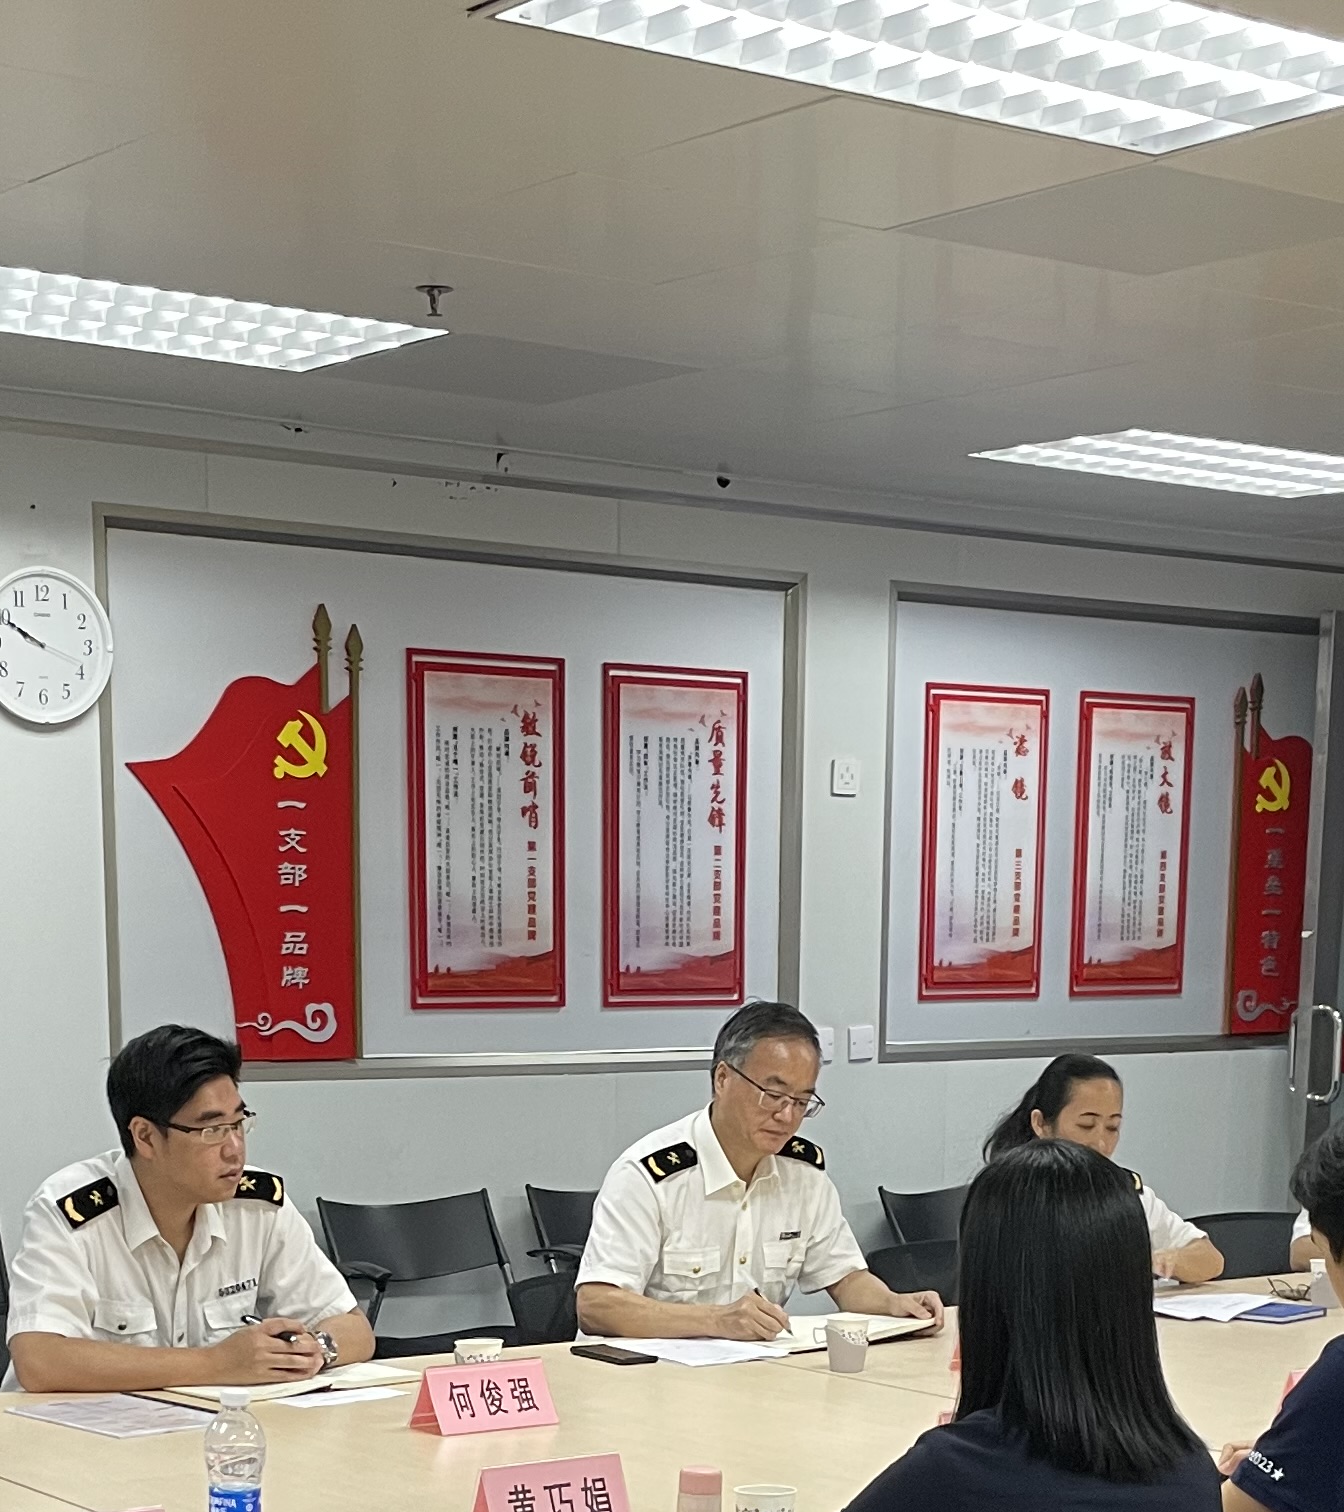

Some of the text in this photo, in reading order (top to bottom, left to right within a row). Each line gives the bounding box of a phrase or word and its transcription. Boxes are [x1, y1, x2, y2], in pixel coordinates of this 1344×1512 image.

[13, 590, 25, 607] 11
[35, 584, 50, 601] 12
[62, 593, 68, 610] 1
[77, 613, 86, 630] 2
[83, 639, 93, 656] 3
[0, 661, 9, 677] 8
[75, 663, 85, 680] 4
[16, 681, 25, 697] 7
[39, 688, 48, 705] 6
[62, 683, 71, 700] 5
[708, 720, 726, 834] 质量先锋
[277, 800, 310, 989] 一支部一品牌
[448, 1377, 540, 1420] 何俊强
